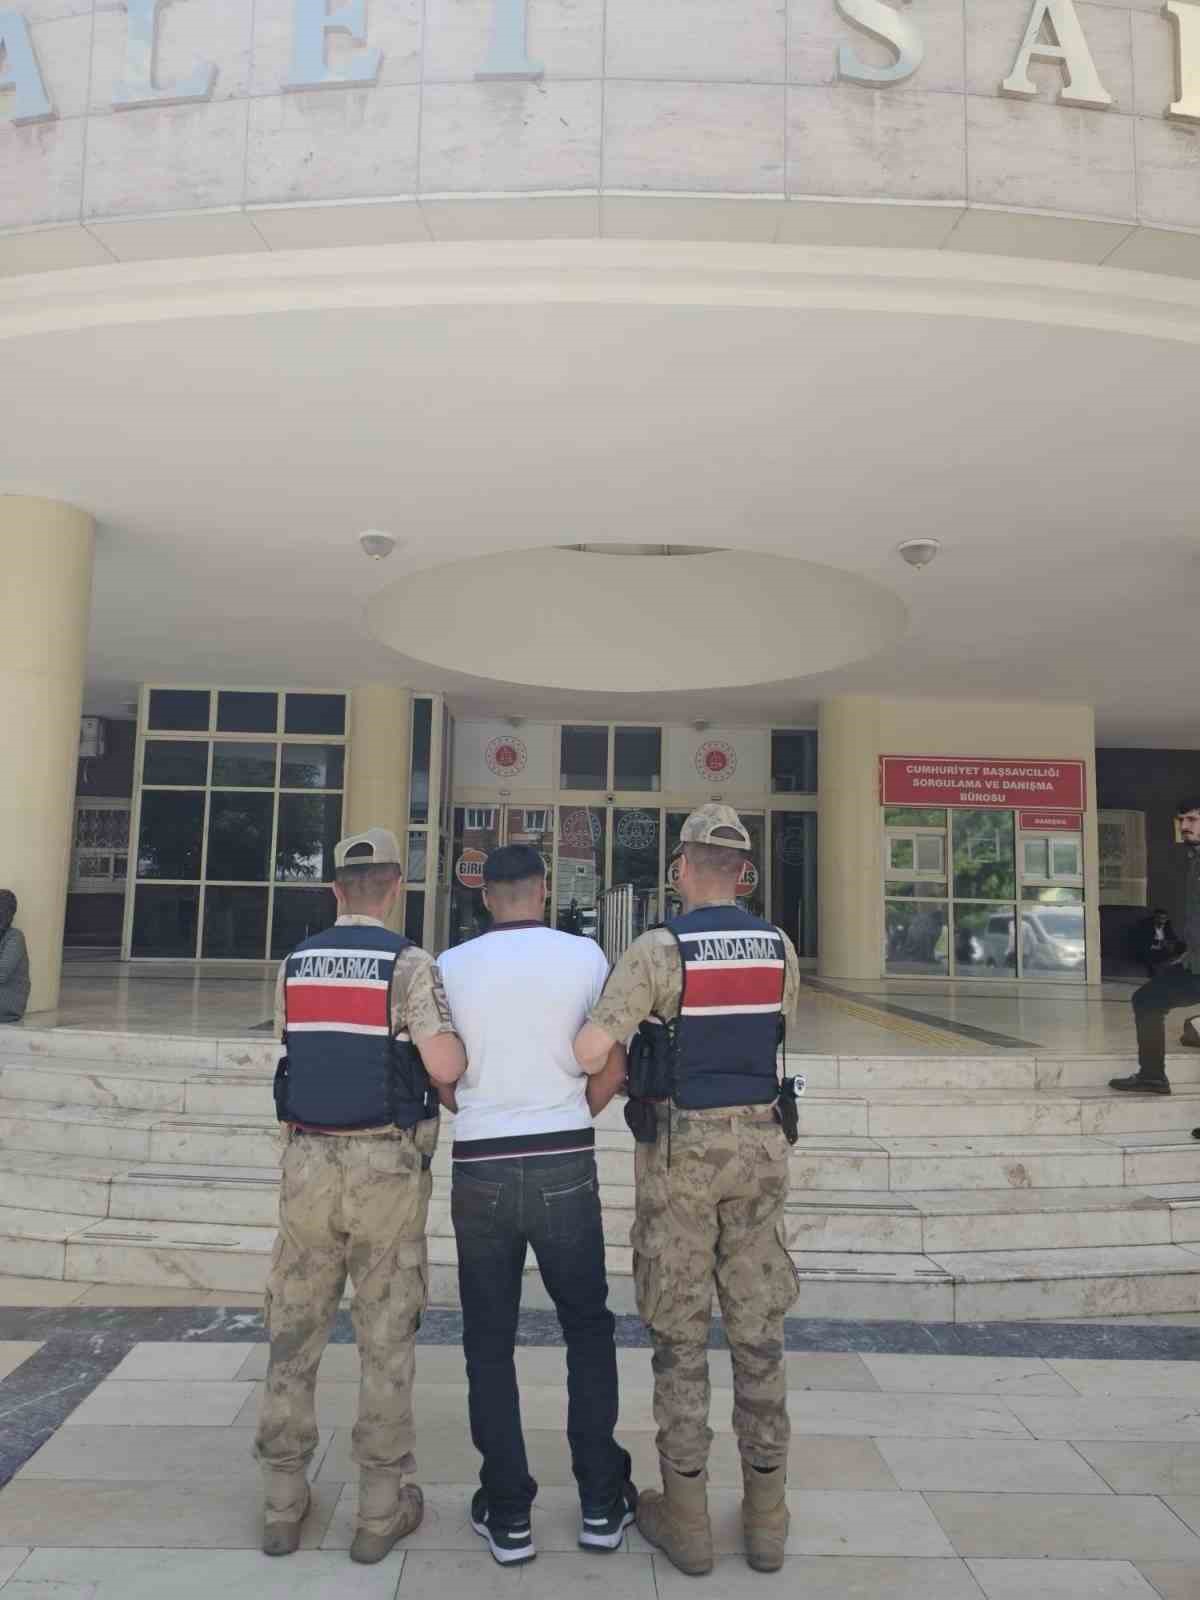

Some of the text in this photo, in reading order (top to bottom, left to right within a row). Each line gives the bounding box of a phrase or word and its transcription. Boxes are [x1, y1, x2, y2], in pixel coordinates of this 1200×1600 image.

[838, 0, 1200, 124] SA
[905, 764, 979, 776] CUMHURİYET
[912, 778, 982, 789] SORGULAMA
[985, 780, 1000, 789] VE
[694, 937, 777, 960] JANDARMA
[295, 956, 380, 979] JANDARMA
